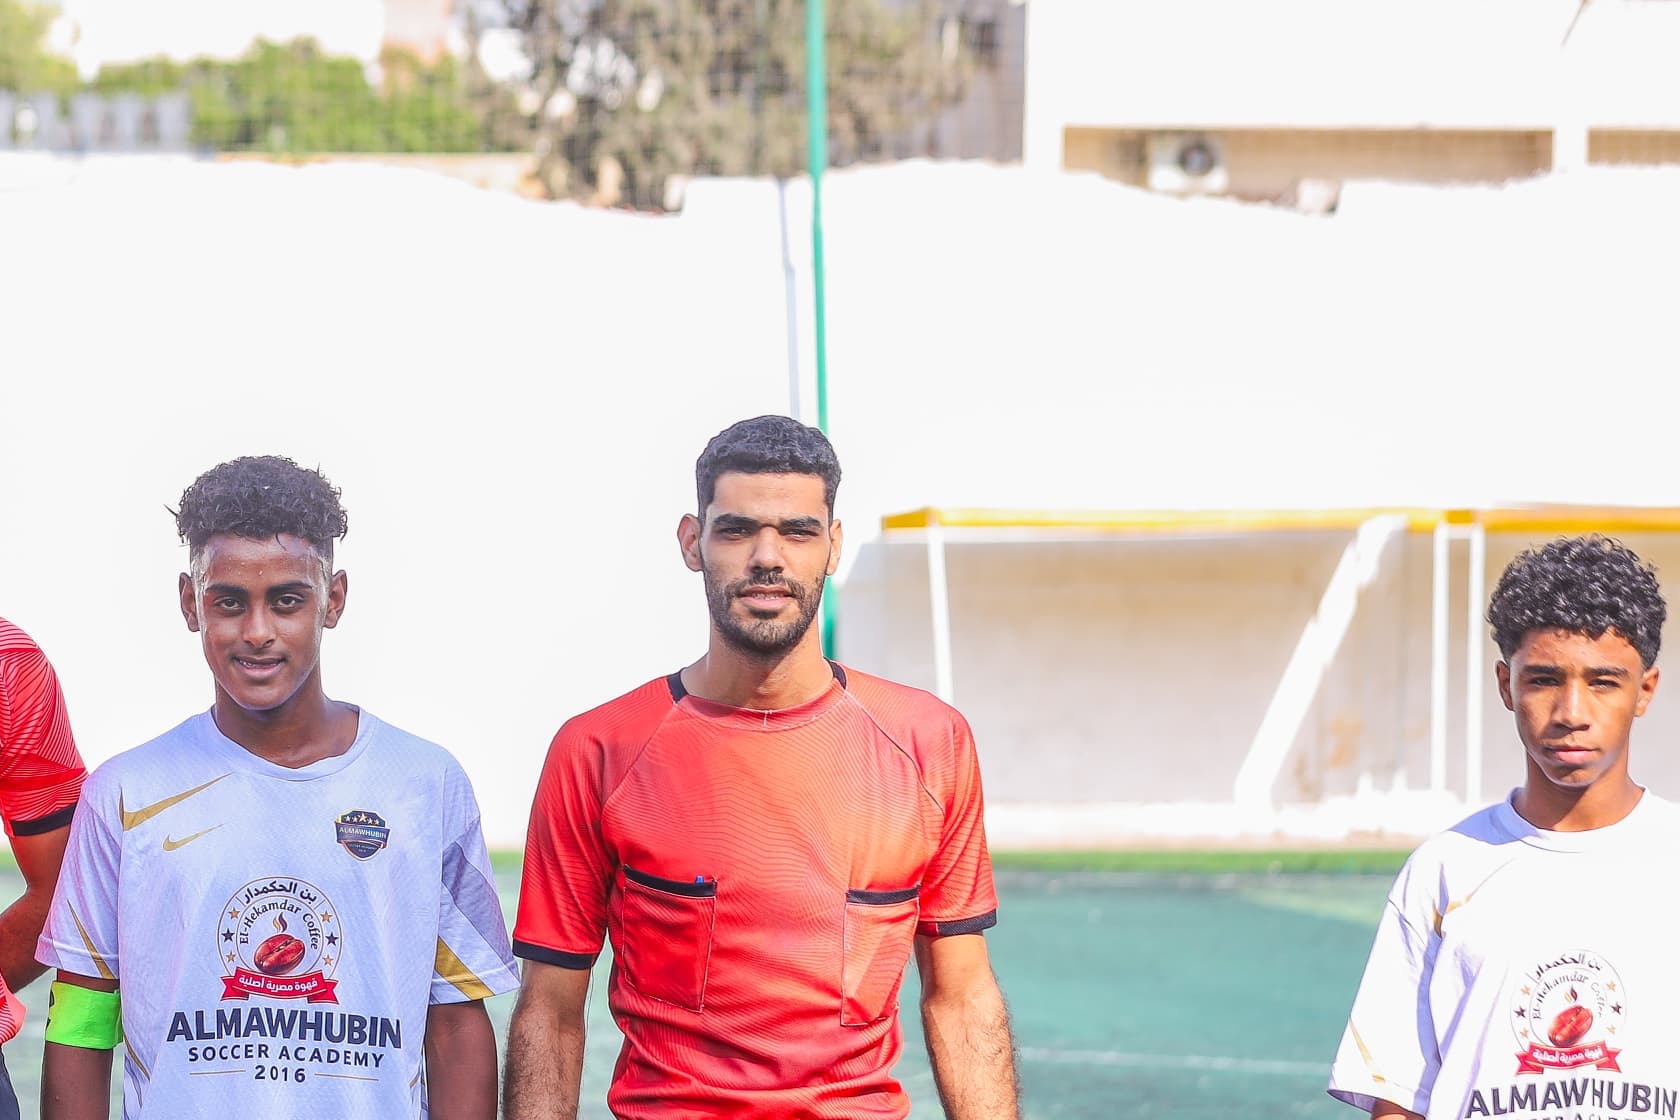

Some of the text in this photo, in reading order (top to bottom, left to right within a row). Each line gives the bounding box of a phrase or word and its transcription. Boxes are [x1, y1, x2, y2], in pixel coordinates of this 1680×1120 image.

[241, 880, 317, 905] بن الحكمدار
[239, 899, 321, 950] El-Hekamdar Coffee
[166, 1006, 403, 1050] ALMAWHUBIN
[188, 1043, 385, 1069] SOCCER ACADEMY
[254, 1064, 307, 1083] 2016
[1464, 1078, 1678, 1119] ALMAWHUBIN
